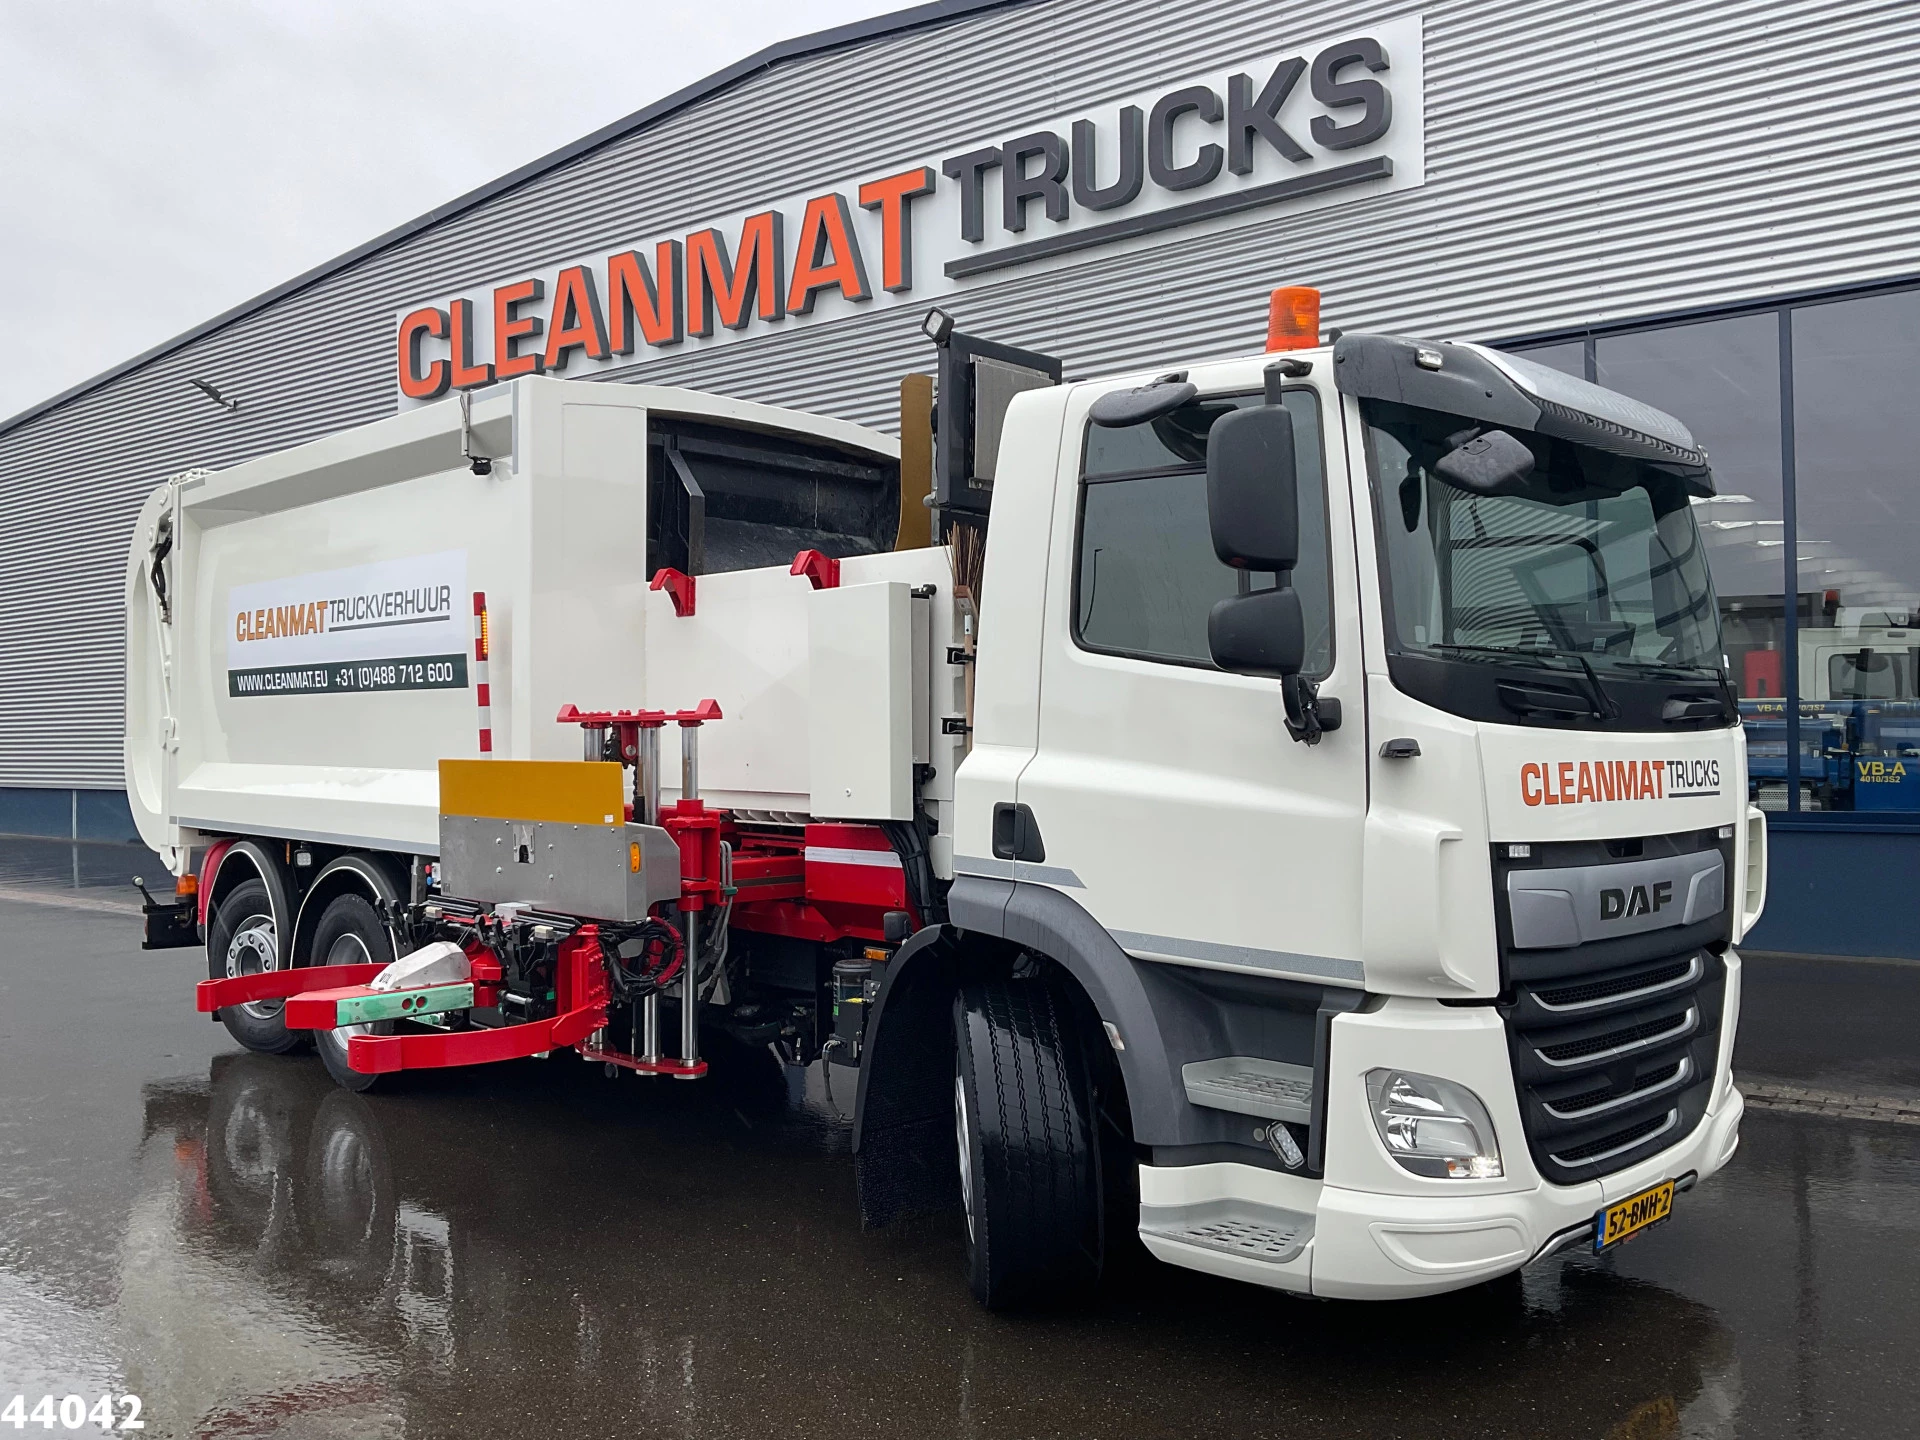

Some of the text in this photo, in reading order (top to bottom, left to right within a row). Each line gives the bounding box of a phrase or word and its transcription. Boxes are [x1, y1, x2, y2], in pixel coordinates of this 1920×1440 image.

[398, 37, 1393, 399] CLEANMAT TRUCKS
[236, 585, 450, 642] CLEANMAT TRUCKVERHUUR
[237, 662, 453, 692] WWW.CLEANMAT.EU +31 (0)488 712 600
[1520, 759, 1720, 807] CLEANMAT TRUCKS
[1857, 761, 1907, 776] VB-A
[1599, 881, 1672, 921] DAF
[1608, 1187, 1670, 1238] 52-BNH-2
